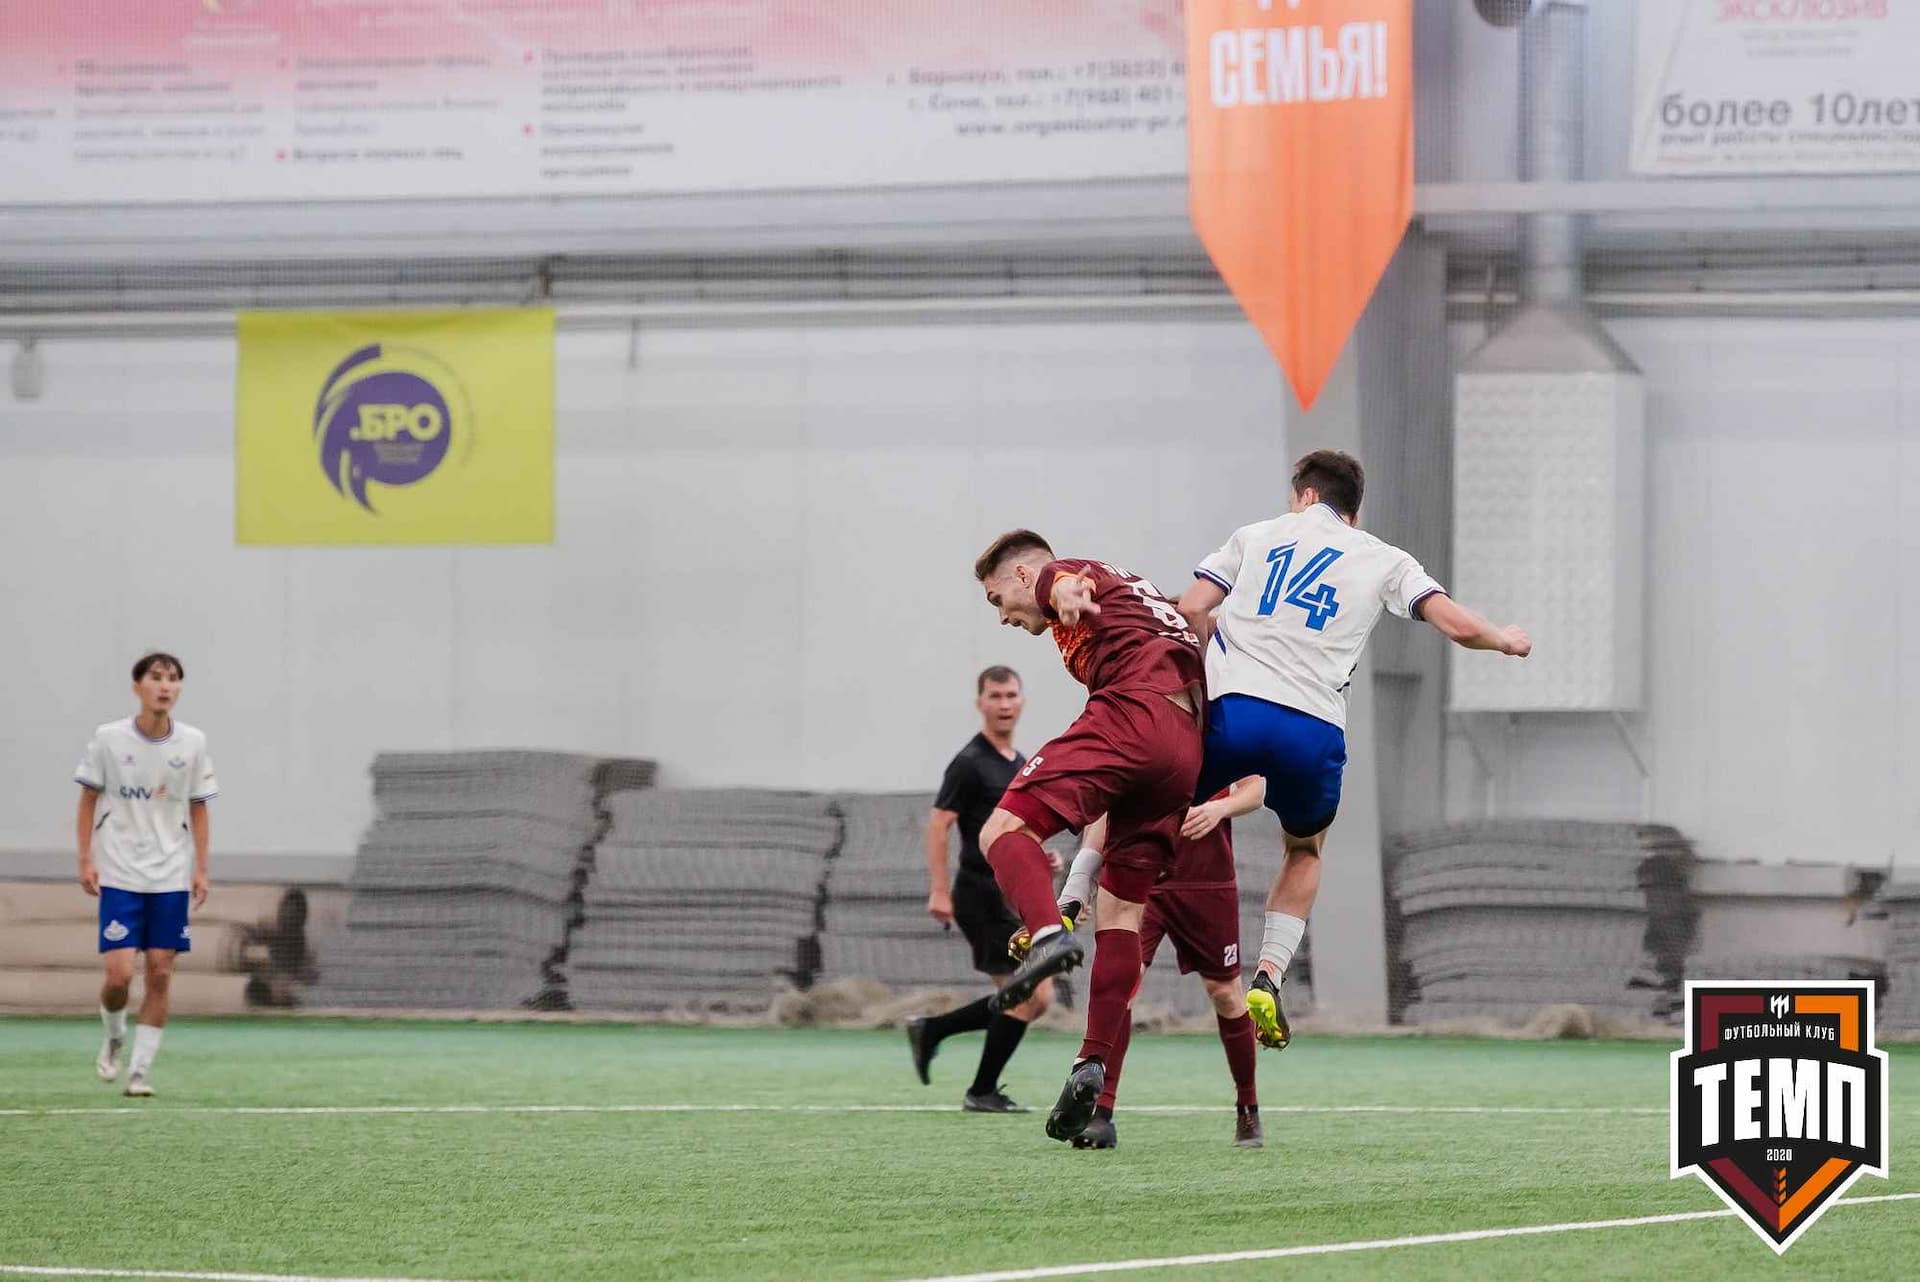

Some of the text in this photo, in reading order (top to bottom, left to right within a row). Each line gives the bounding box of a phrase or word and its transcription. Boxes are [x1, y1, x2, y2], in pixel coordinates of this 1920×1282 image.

[1210, 20, 1387, 107] СЕМЬЯ!
[1663, 90, 1793, 127] более
[350, 403, 442, 441] .БРО
[1256, 541, 1344, 632] 14
[1223, 943, 1238, 968] 23
